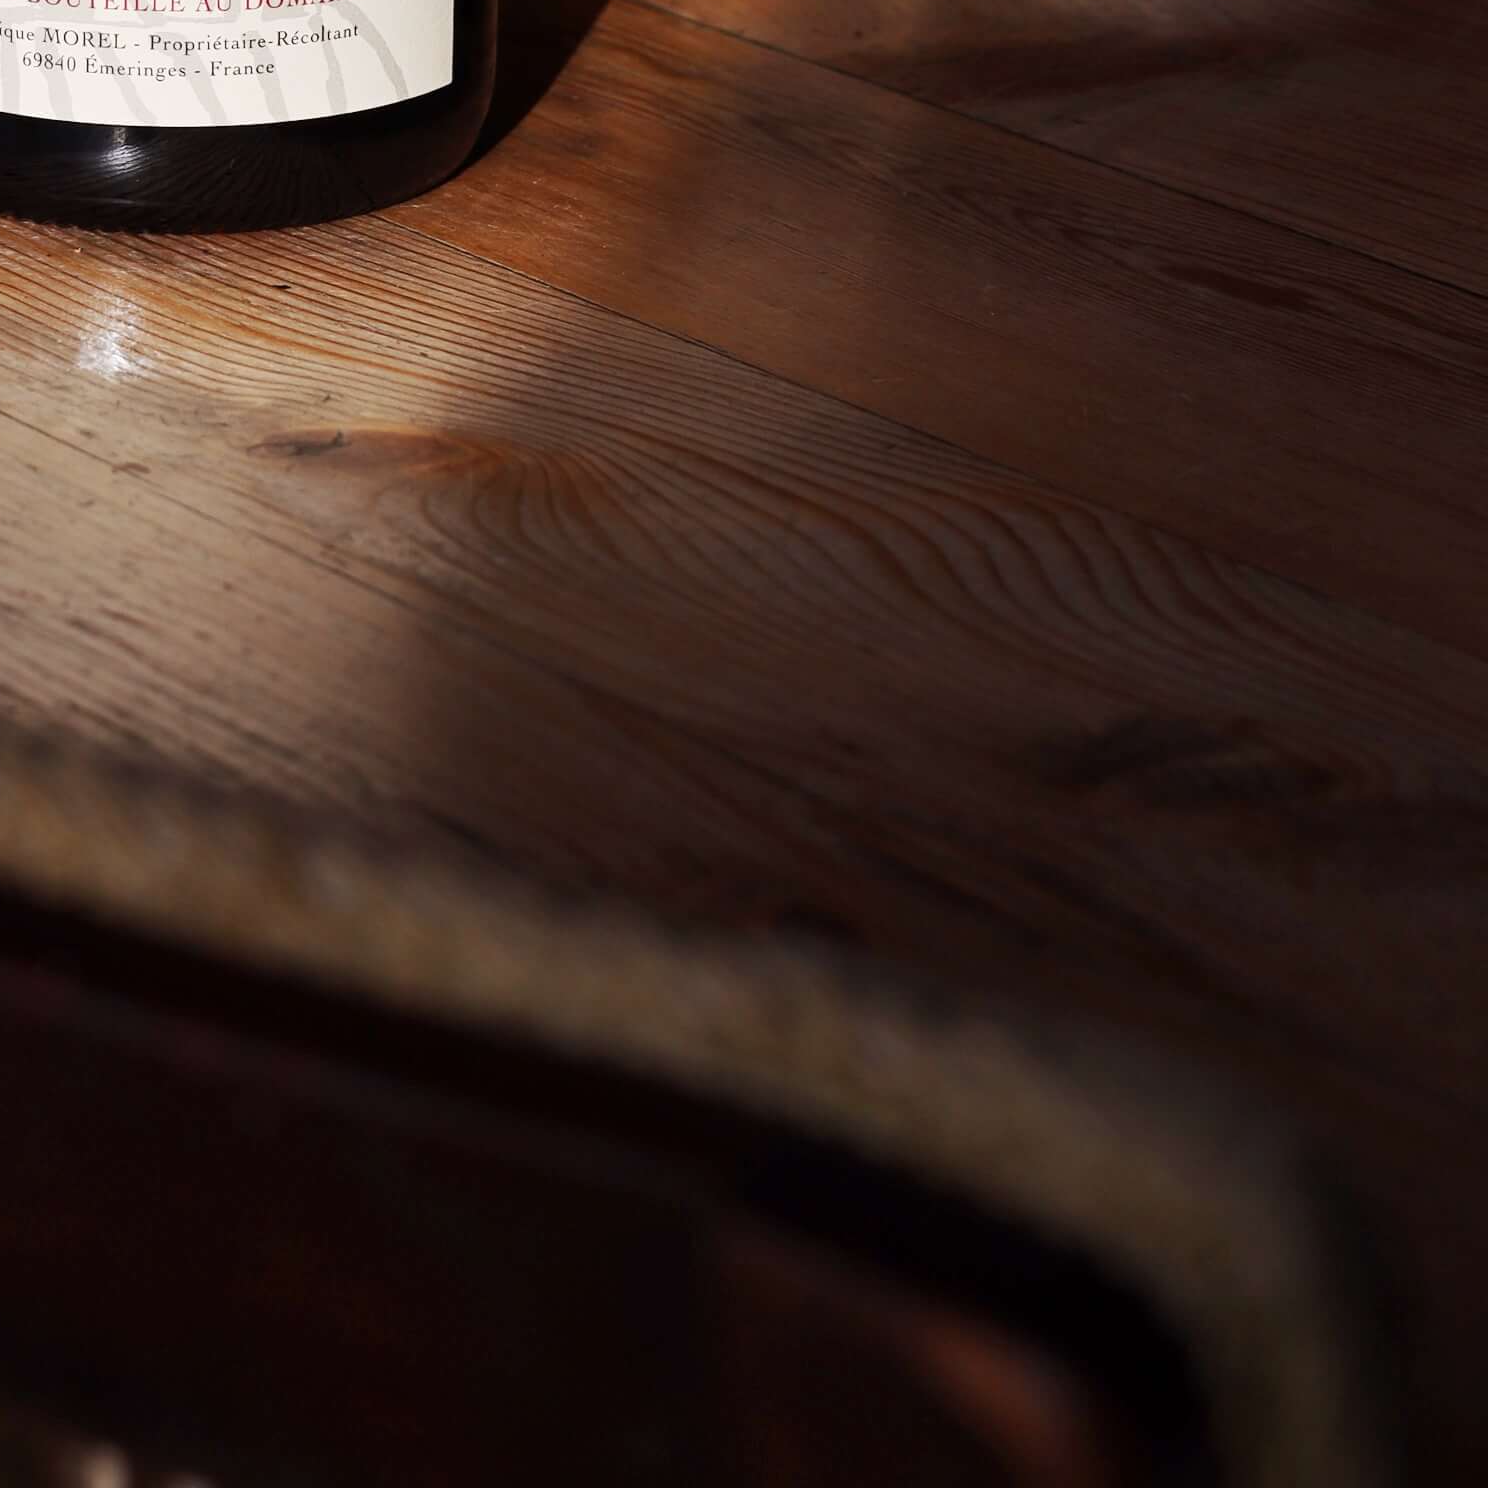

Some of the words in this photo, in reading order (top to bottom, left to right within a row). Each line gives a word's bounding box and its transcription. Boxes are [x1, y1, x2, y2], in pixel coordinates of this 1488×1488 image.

[42, 28, 126, 48] MOREL
[149, 24, 358, 55] Propriétaire-Récoltant
[22, 54, 76, 72] 69840
[85, 55, 186, 81] Émeringes
[209, 59, 274, 76] France
